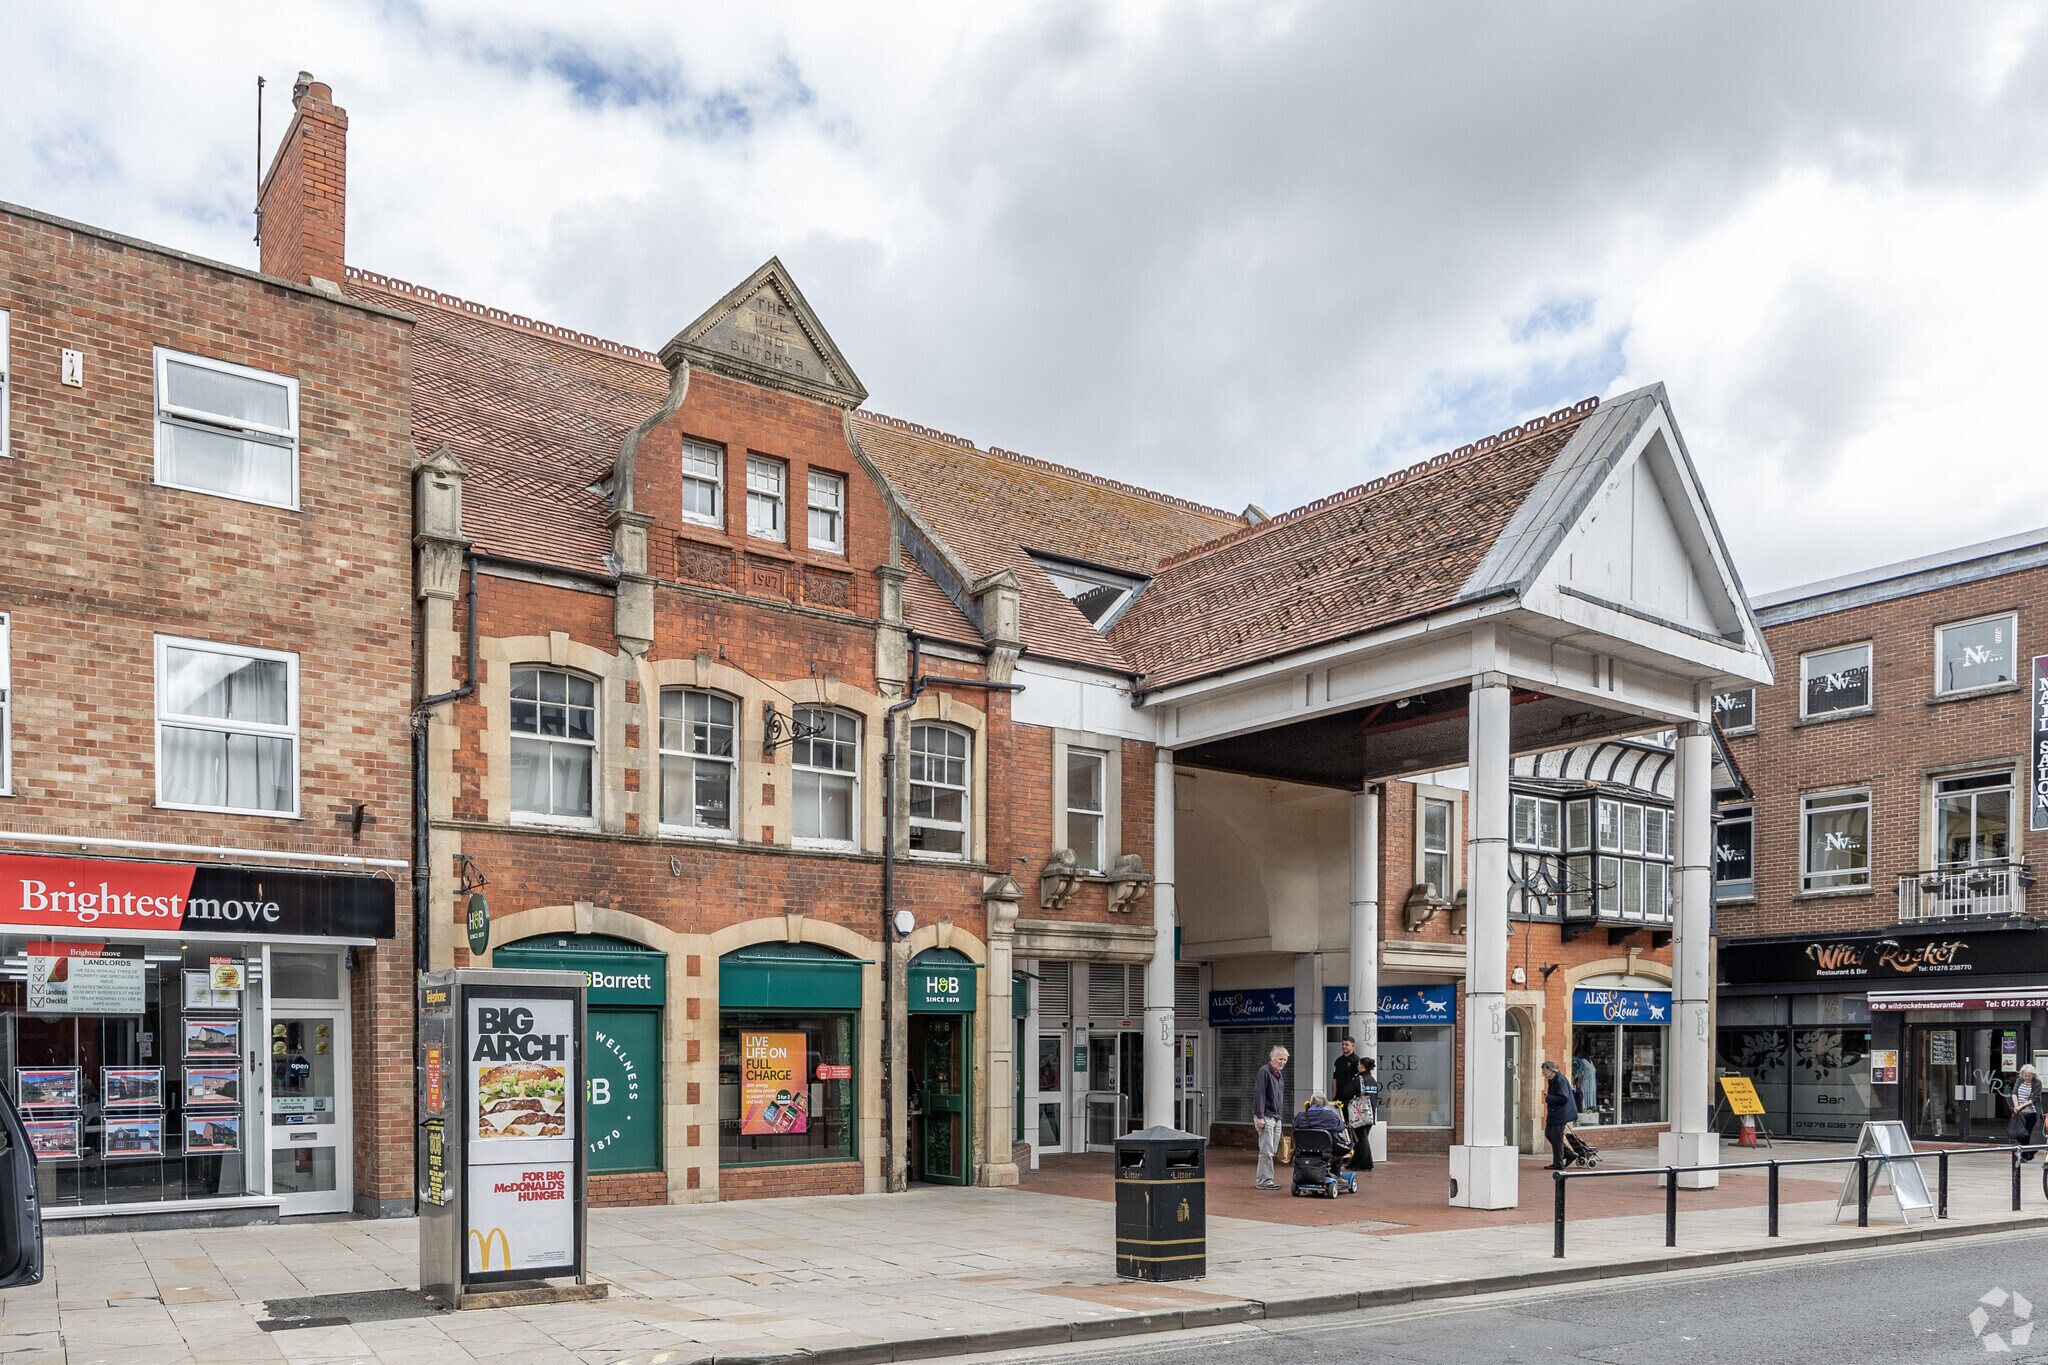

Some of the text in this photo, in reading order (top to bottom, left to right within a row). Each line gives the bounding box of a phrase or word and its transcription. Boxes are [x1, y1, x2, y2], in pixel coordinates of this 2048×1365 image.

[756, 297, 786, 316] THE
[753, 331, 784, 348] AND
[753, 571, 778, 588] 1907
[468, 910, 484, 930] H&B
[1806, 940, 1969, 972] Wild Rocket
[926, 976, 959, 994] H&B
[426, 989, 446, 1006] Telephone
[1212, 994, 1265, 1016] ALiSE & Louie
[1377, 996, 1409, 1012] Louie
[1584, 990, 1639, 1020] ALiSE & Louie
[1888, 1001, 1964, 1009] wildrocketrestaurantbar
[478, 1007, 534, 1034] BIG
[472, 1034, 565, 1061] ARCH
[746, 1036, 768, 1047] LIVE
[746, 1048, 787, 1058] LIFE ON
[595, 1031, 638, 1100] WELLNESS
[746, 1059, 771, 1069] FULL
[1378, 1055, 1418, 1071] LiSE
[746, 1070, 792, 1080] CHARGE
[1818, 1095, 1845, 1104] Bar
[590, 1129, 620, 1153] 1870
[522, 1170, 565, 1181] FOR BIG
[494, 1180, 565, 1193] McDONALD'S
[518, 1191, 565, 1201] HUNGER
